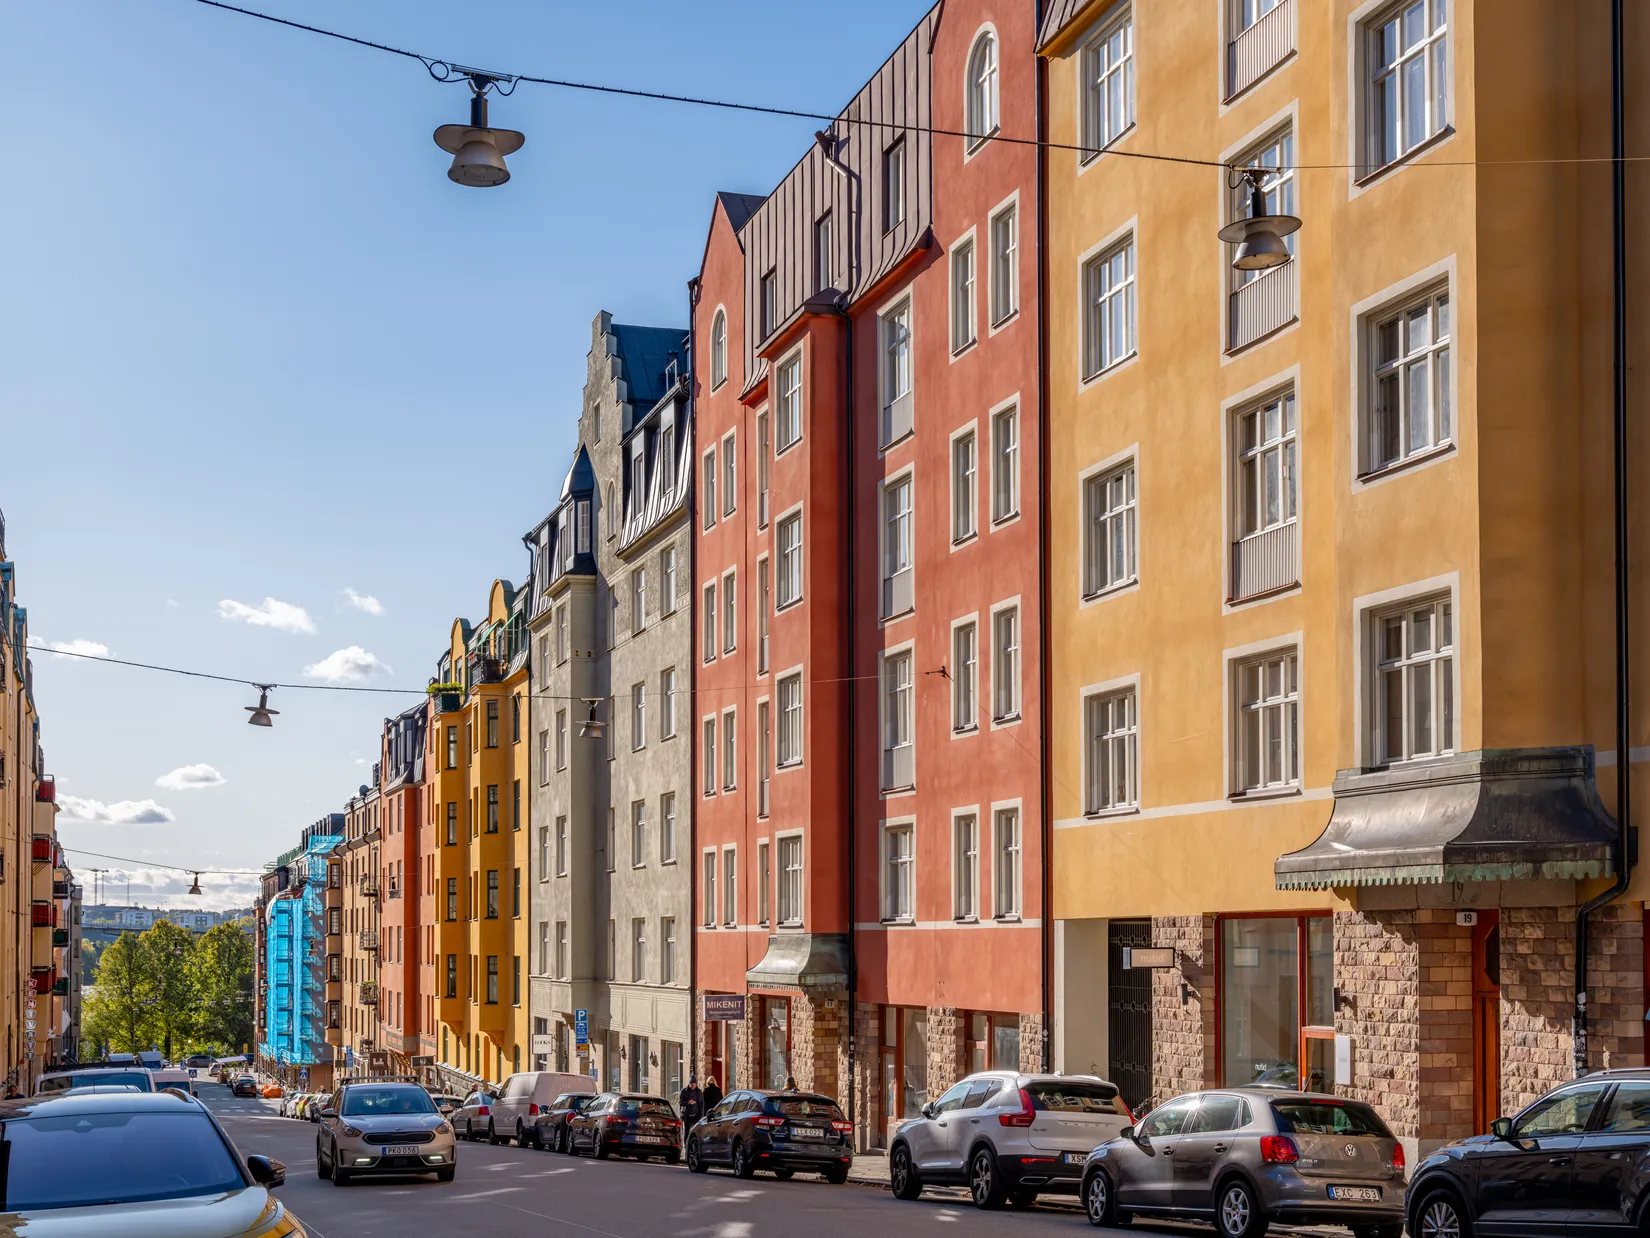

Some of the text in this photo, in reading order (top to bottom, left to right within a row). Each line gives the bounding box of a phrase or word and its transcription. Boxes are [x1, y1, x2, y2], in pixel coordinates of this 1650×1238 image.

[1464, 913, 1472, 923] 19
[1140, 954, 1164, 963] nutid
[706, 1000, 743, 1009] MIKENIT
[578, 1010, 586, 1021] P
[1071, 1154, 1087, 1163] XSM
[1334, 1187, 1377, 1199] EXC 263
